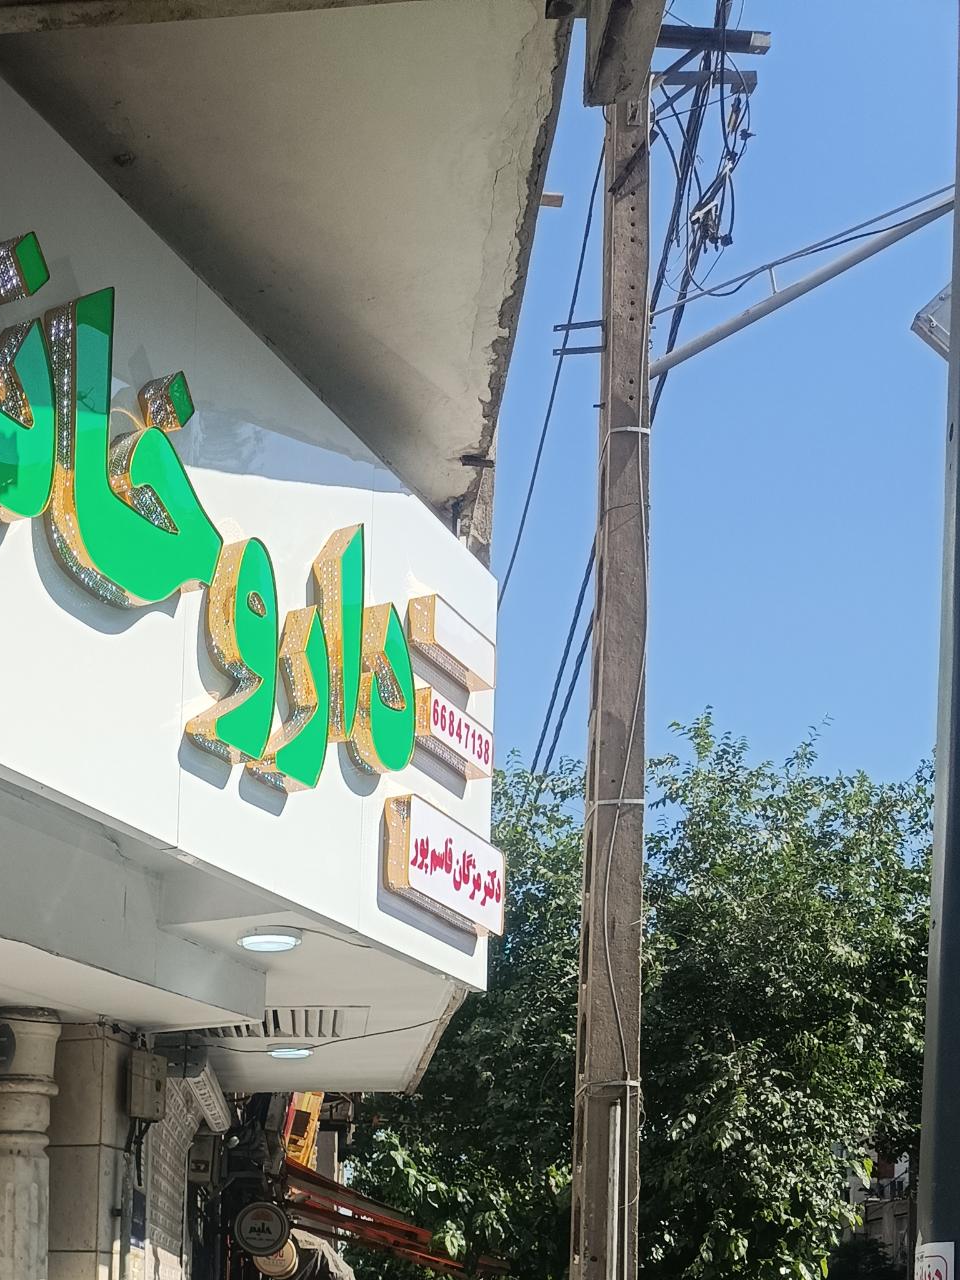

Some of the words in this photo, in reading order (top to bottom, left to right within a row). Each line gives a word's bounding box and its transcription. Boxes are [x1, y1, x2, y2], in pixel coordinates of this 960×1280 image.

[433, 699, 490, 765] 66847138
[452, 850, 482, 901] مژگان
[480, 869, 501, 907] دکتر
